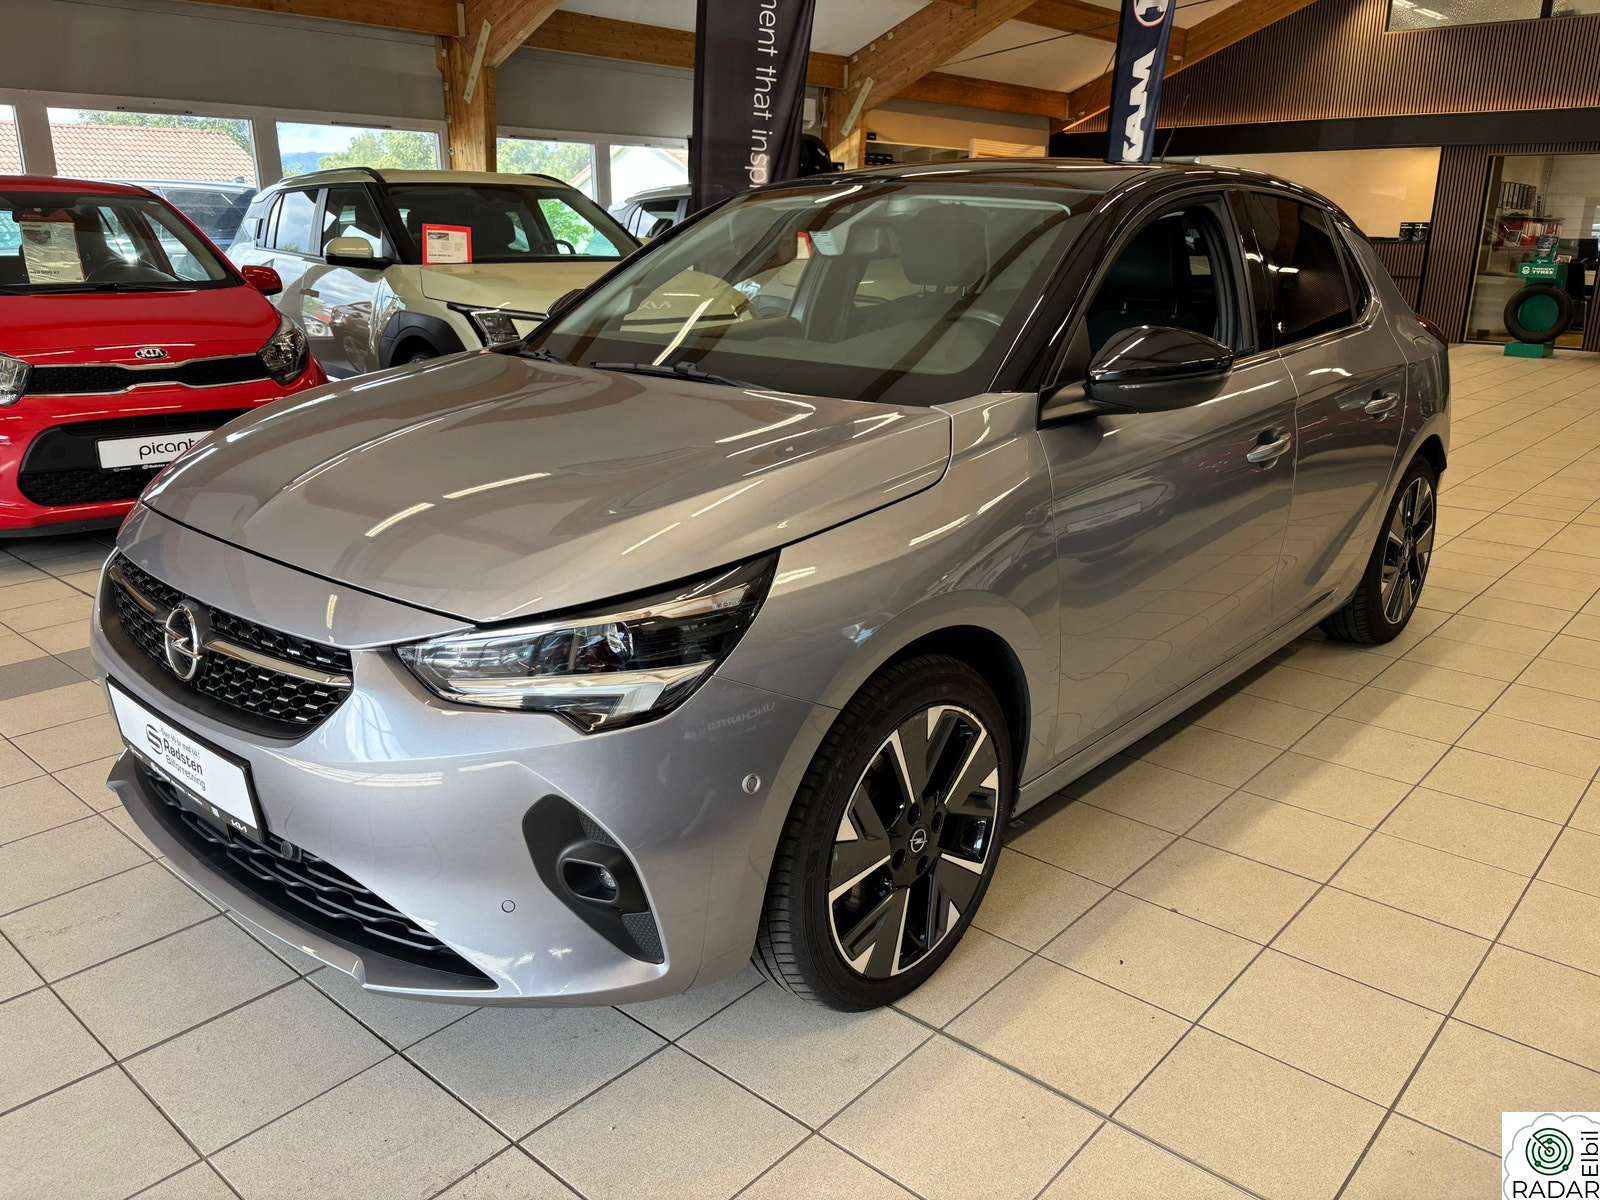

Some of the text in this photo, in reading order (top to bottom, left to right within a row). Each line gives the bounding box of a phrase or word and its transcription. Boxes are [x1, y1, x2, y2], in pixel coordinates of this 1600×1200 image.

[753, 65, 777, 121] that
[140, 348, 164, 358] KIA
[165, 754, 206, 791] Bilforretning
